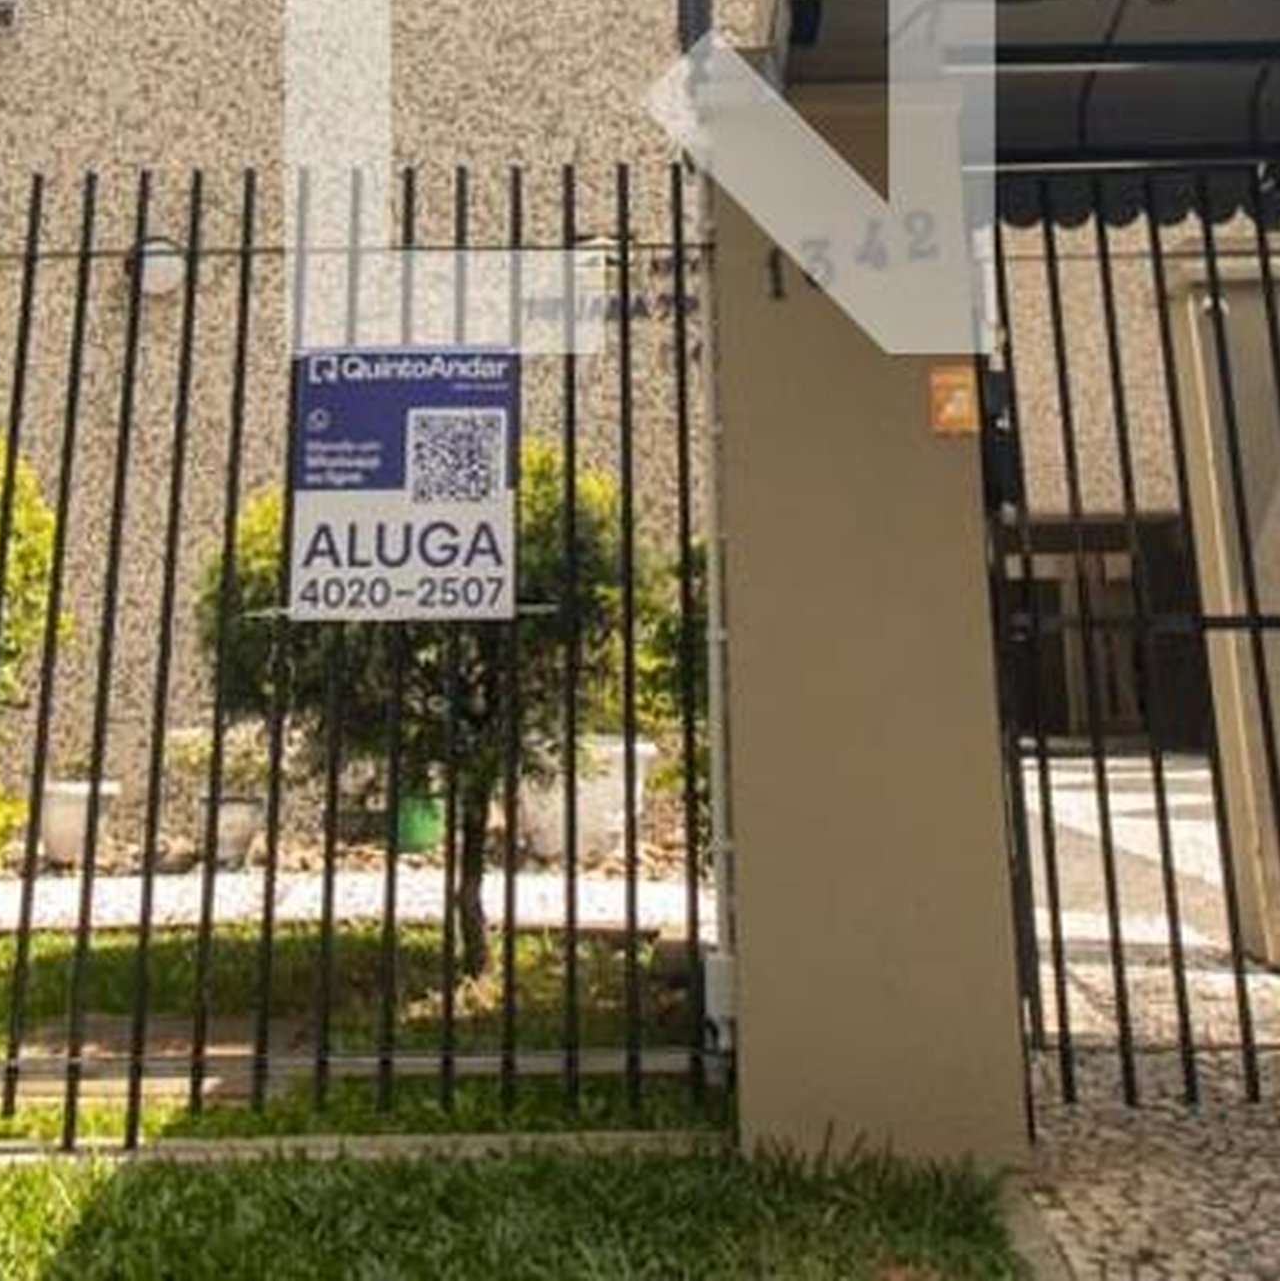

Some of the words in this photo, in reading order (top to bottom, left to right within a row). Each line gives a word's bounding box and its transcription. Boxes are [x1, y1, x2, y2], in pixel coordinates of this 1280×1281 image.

[341, 355, 508, 380] QuintoAndar
[302, 522, 504, 567] ALUGA
[300, 577, 505, 608] 4020-2507
